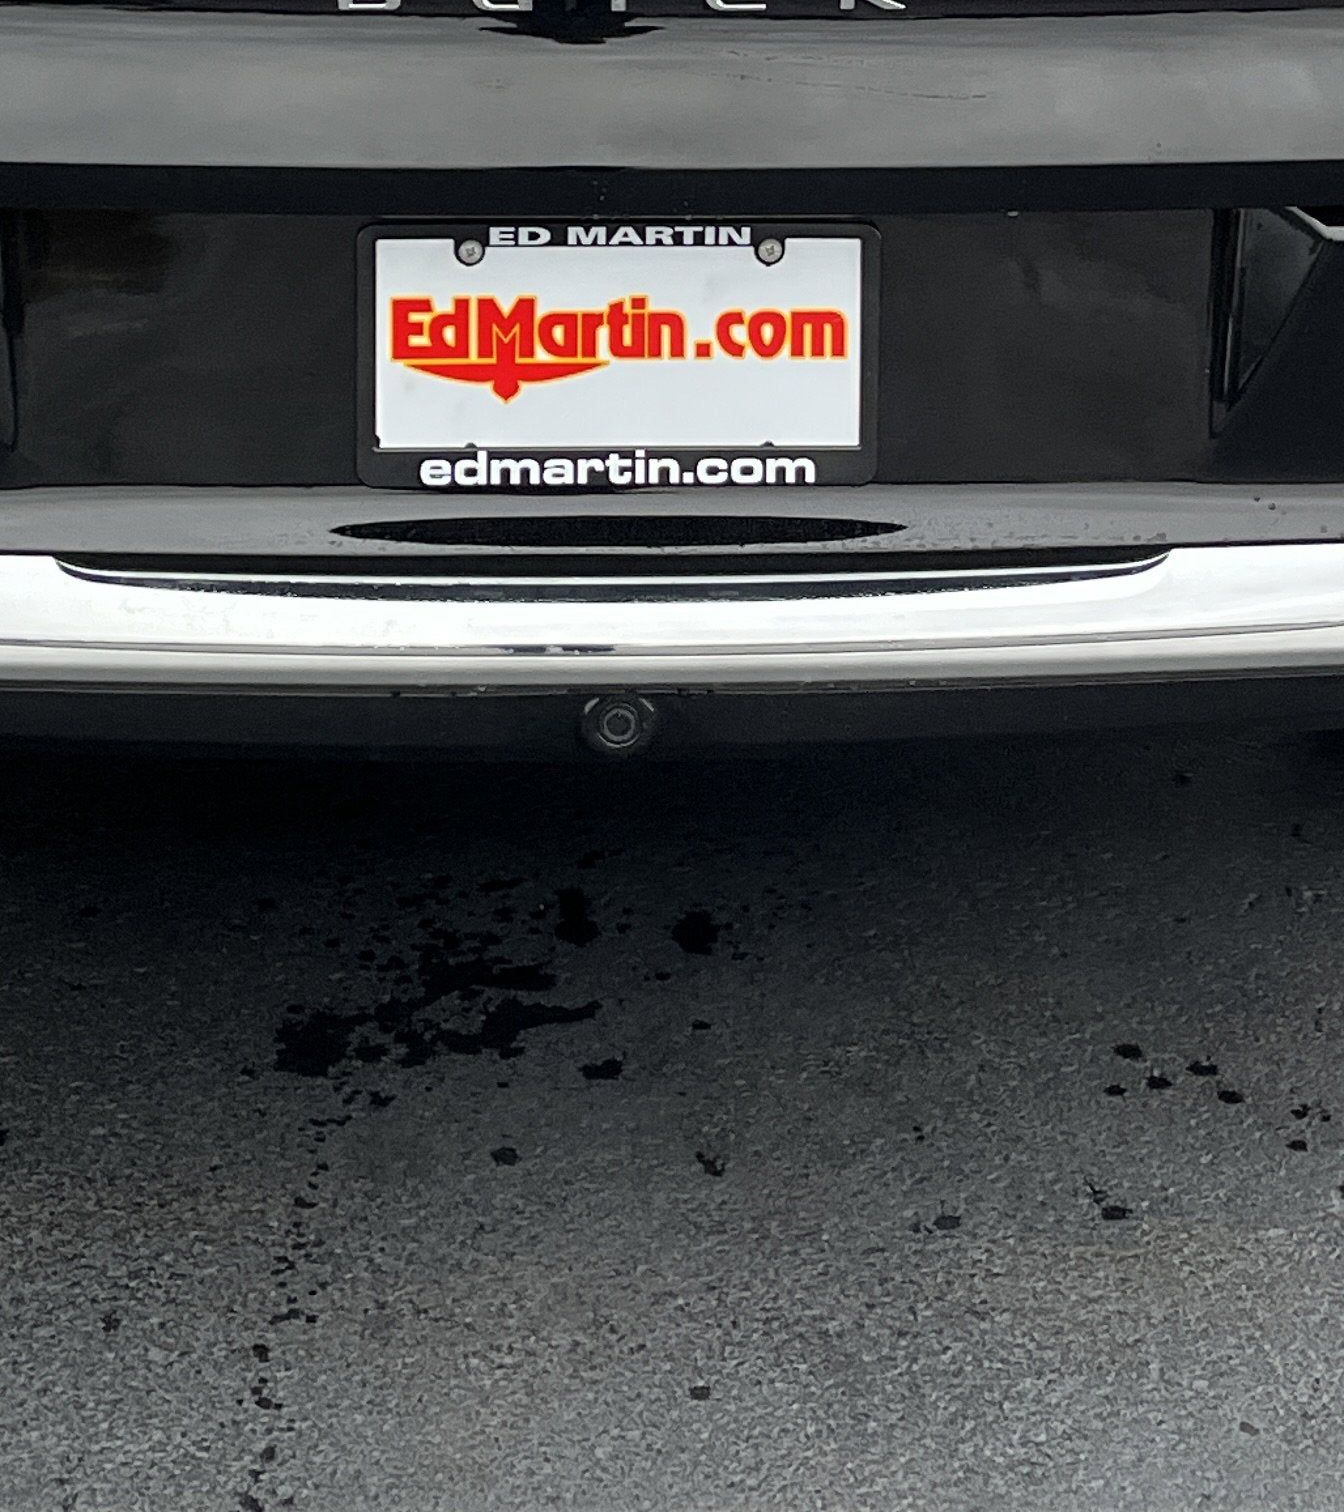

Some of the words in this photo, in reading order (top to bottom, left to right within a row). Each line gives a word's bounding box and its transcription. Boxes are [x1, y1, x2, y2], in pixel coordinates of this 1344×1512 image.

[487, 226, 551, 248] ED
[566, 225, 753, 248] MARTIN
[418, 450, 816, 486] edmartin.com
